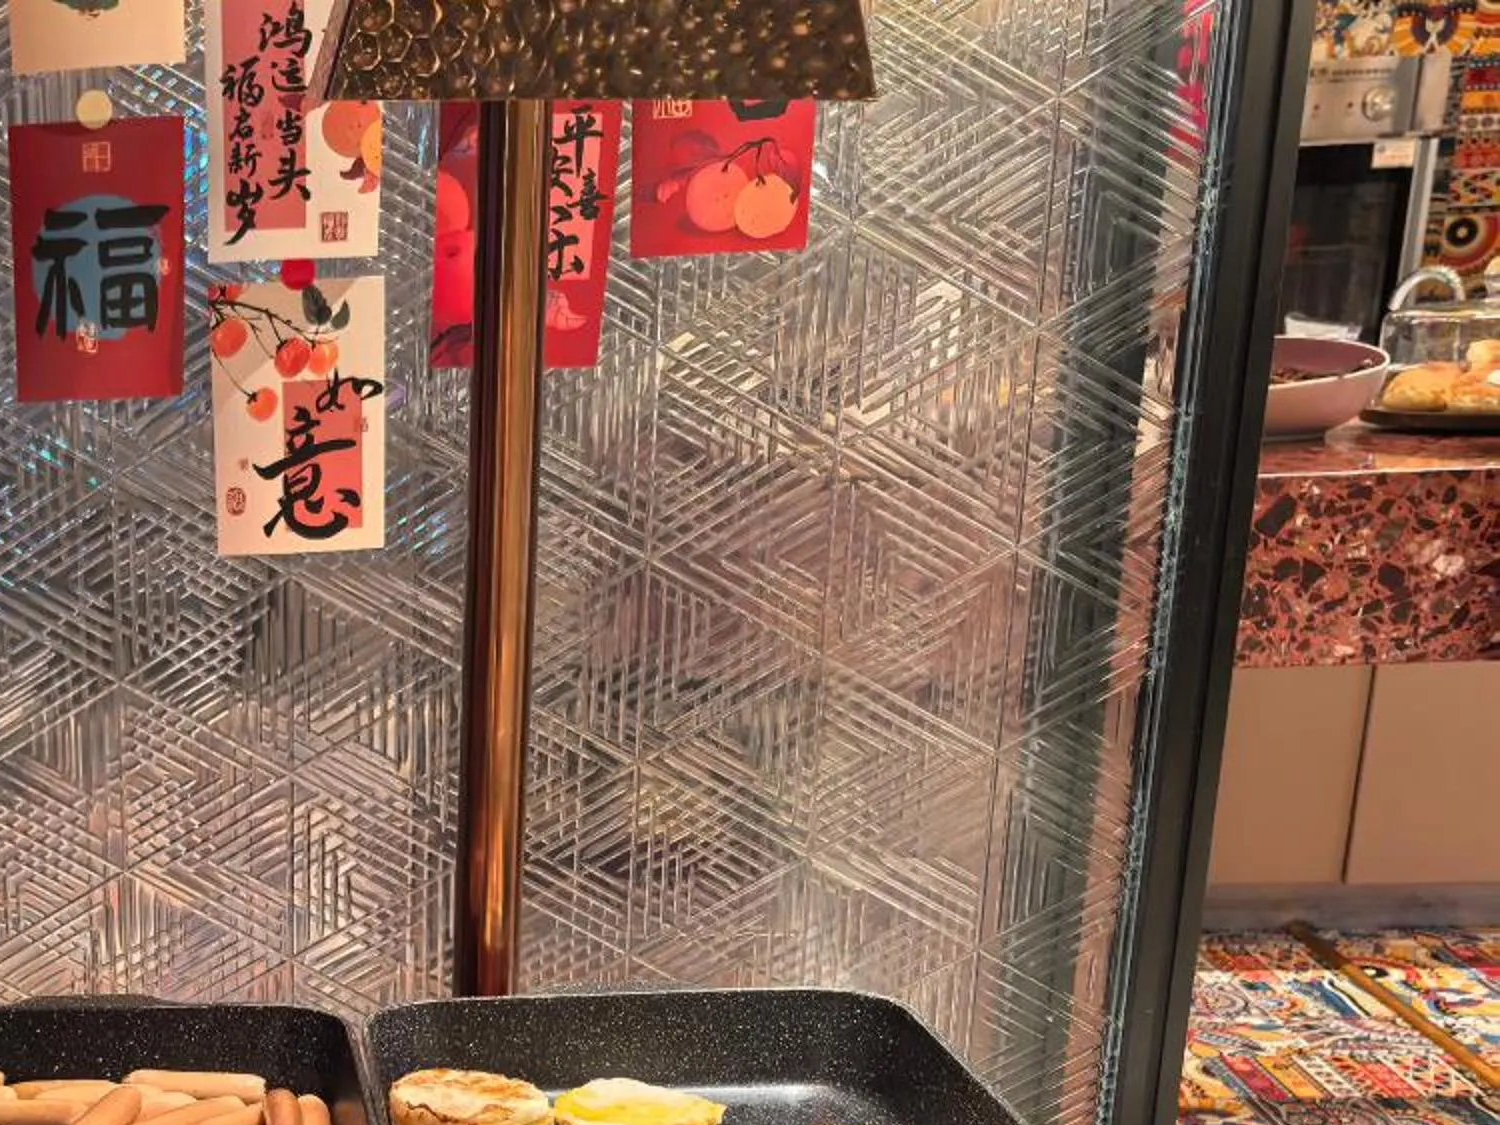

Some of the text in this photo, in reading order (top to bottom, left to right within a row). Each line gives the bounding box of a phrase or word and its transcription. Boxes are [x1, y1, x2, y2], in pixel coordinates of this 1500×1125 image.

[258, 2, 313, 202] 鸿运当头
[31, 204, 170, 340] 福
[252, 366, 384, 540] 如意
